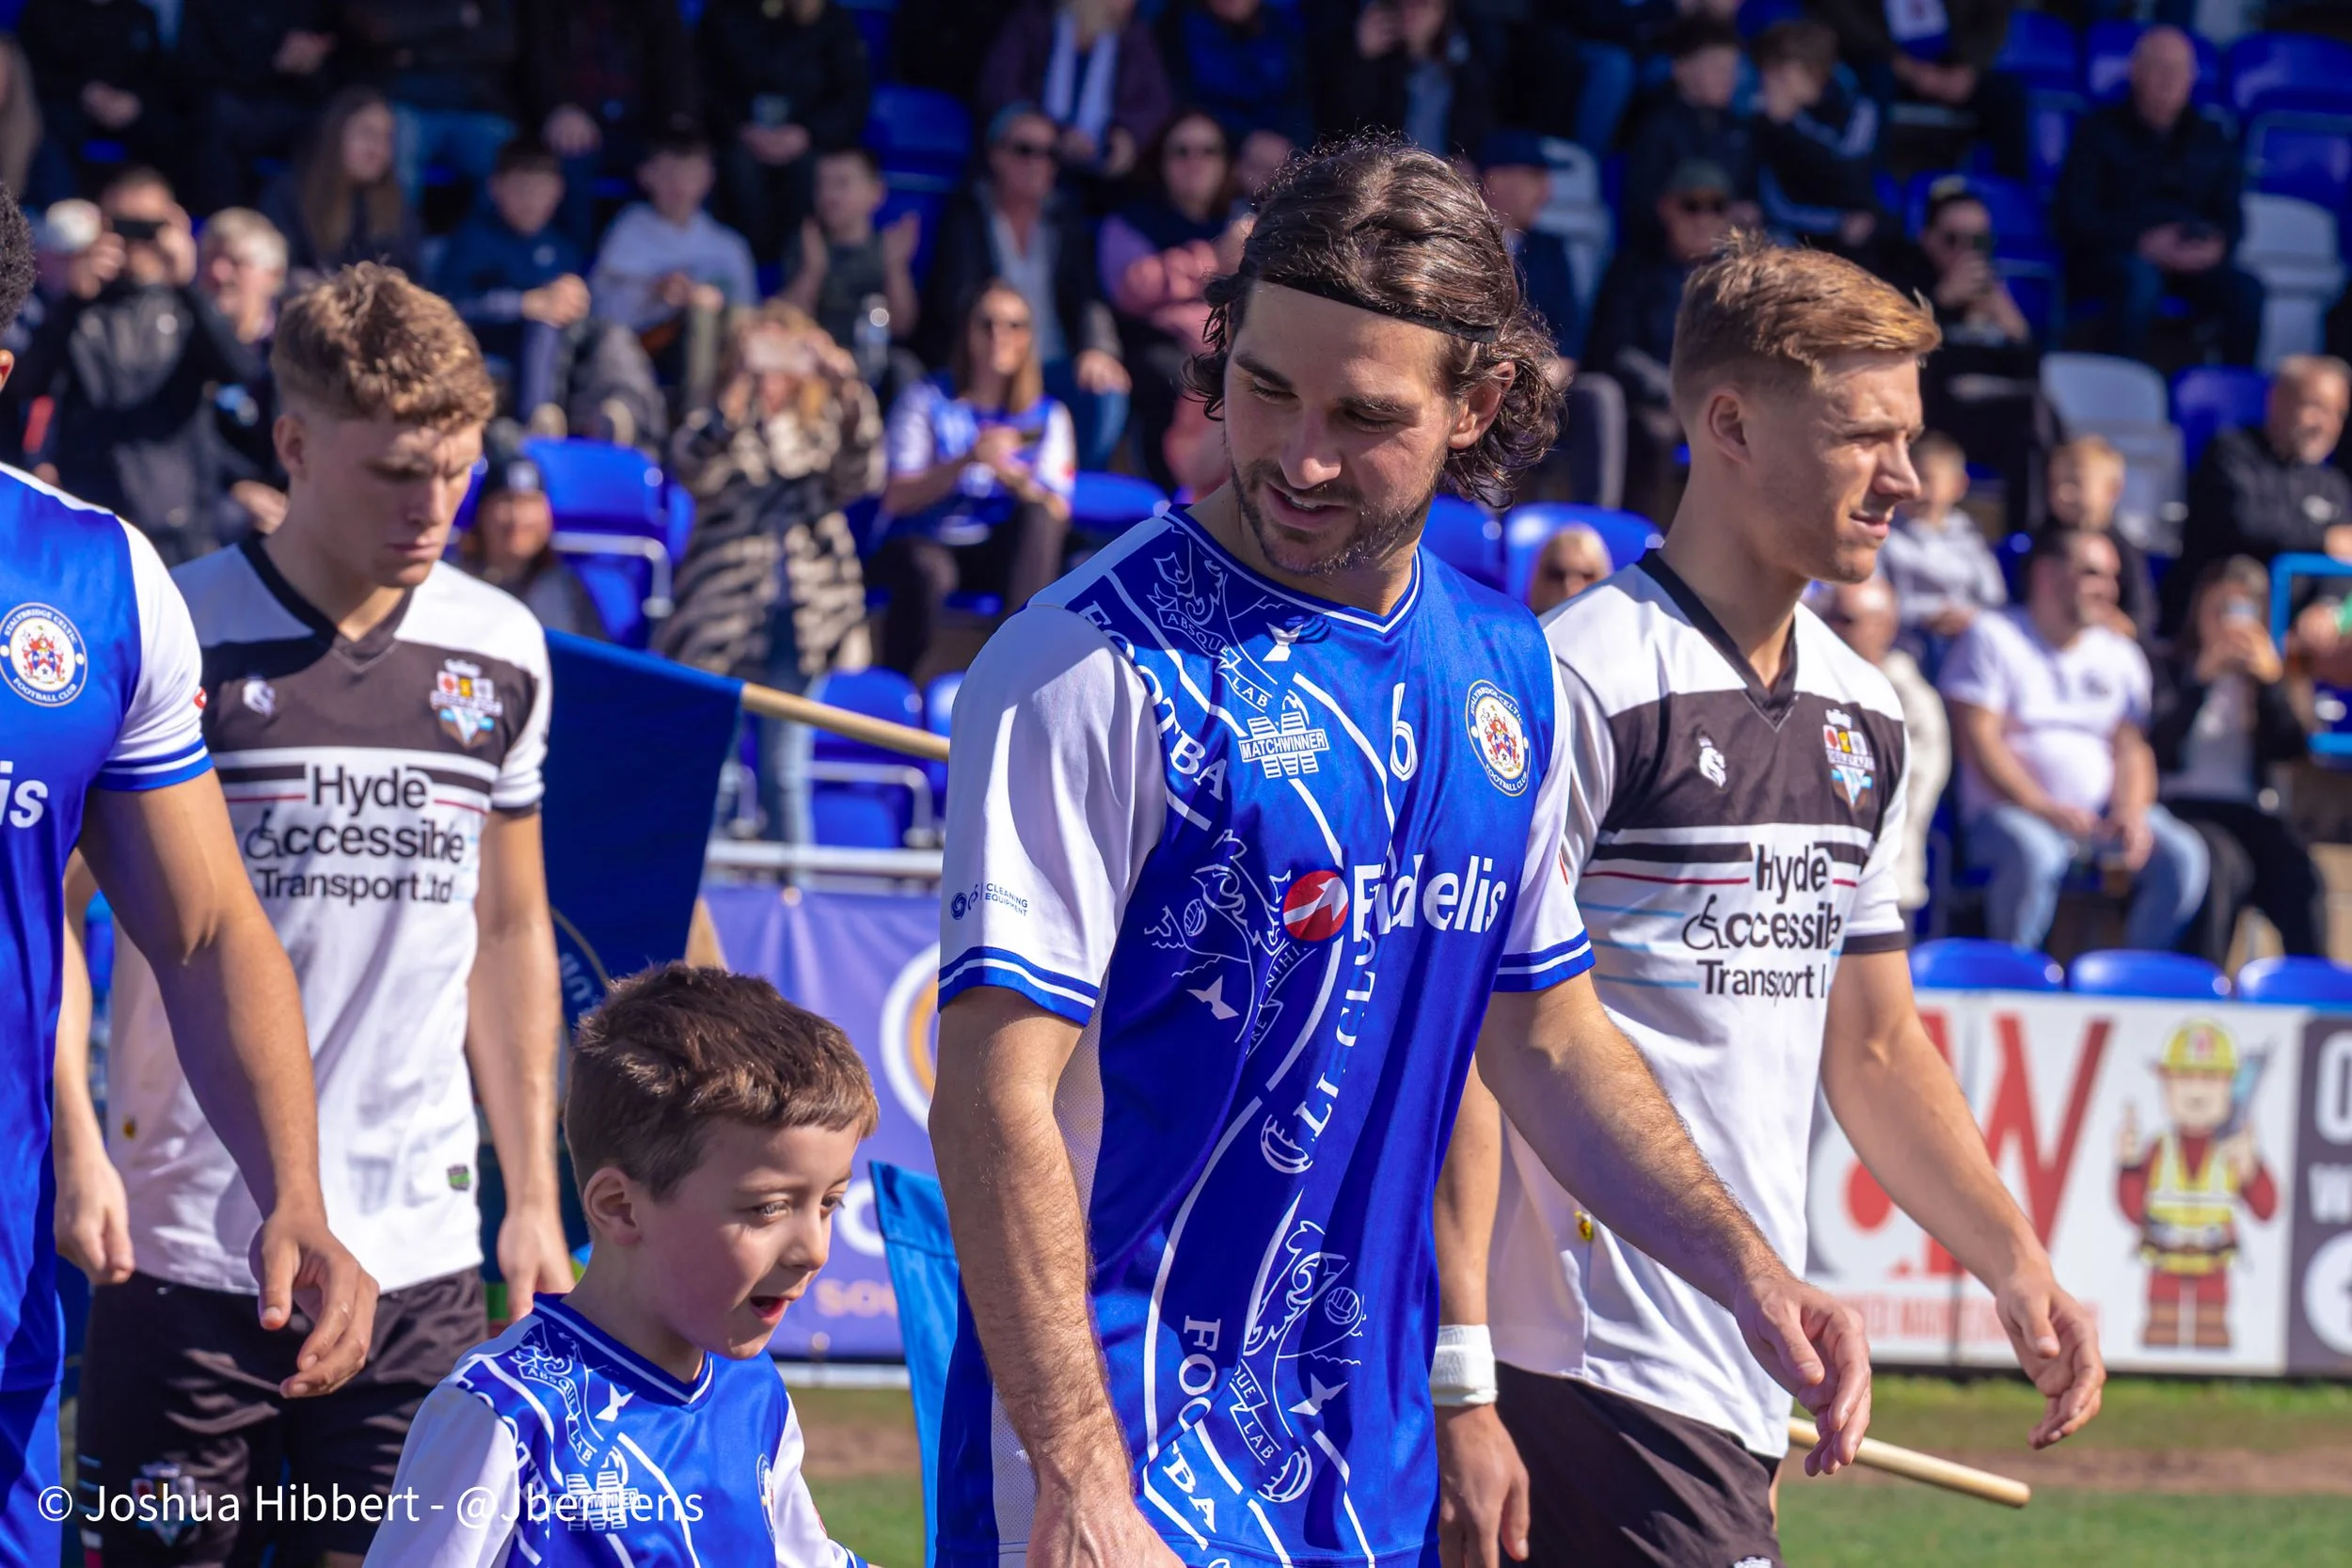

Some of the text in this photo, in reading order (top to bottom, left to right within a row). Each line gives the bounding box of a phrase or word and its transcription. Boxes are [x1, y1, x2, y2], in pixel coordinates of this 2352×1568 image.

[1166, 612, 1229, 658] ABSQUE
[13, 677, 77, 702] FOOTBALL CLUB
[1232, 677, 1268, 707] LAB
[1241, 734, 1327, 761] MATCHWINNER
[1390, 682, 1419, 782] 6
[312, 764, 427, 818] Hyde
[255, 867, 419, 907] Transport
[1756, 844, 1828, 905] Hyde
[985, 893, 1027, 917] EQUIPMENT
[986, 883, 1028, 909] CLEANING
[1265, 945, 1309, 989] NIHI
[570, 1430, 594, 1462] LAB
[1244, 1420, 1274, 1461] LAB
